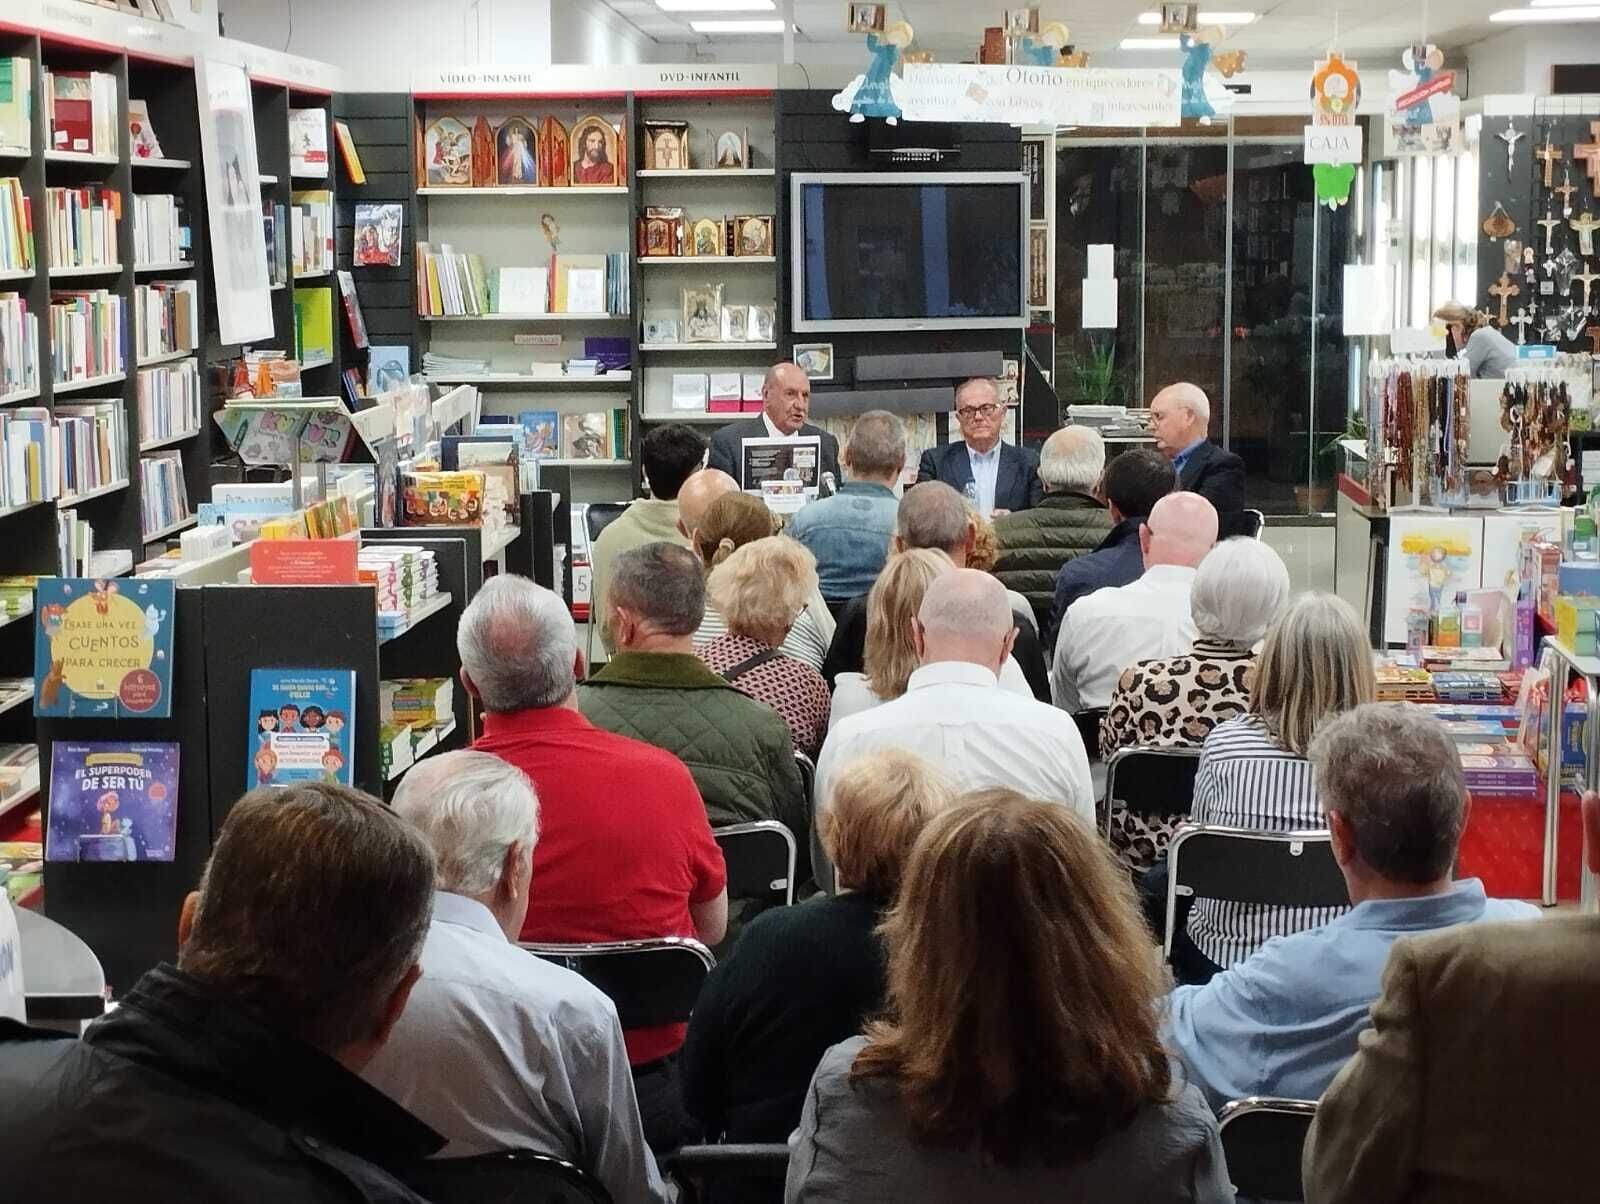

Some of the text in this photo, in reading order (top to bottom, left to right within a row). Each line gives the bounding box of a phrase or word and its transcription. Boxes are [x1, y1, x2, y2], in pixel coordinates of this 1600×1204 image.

[660, 71, 740, 82] DVD-INFANTIL
[1006, 66, 1063, 88] Otoño
[1310, 135, 1350, 151] CAJA
[96, 620, 114, 630] UNA
[120, 620, 137, 630] VEZ
[69, 635, 140, 652] CUENTOS
[65, 658, 139, 668] PARA CRECER
[75, 765, 152, 779] EL SUPERPODER
[82, 779, 99, 791] DE
[101, 776, 126, 789] SER
